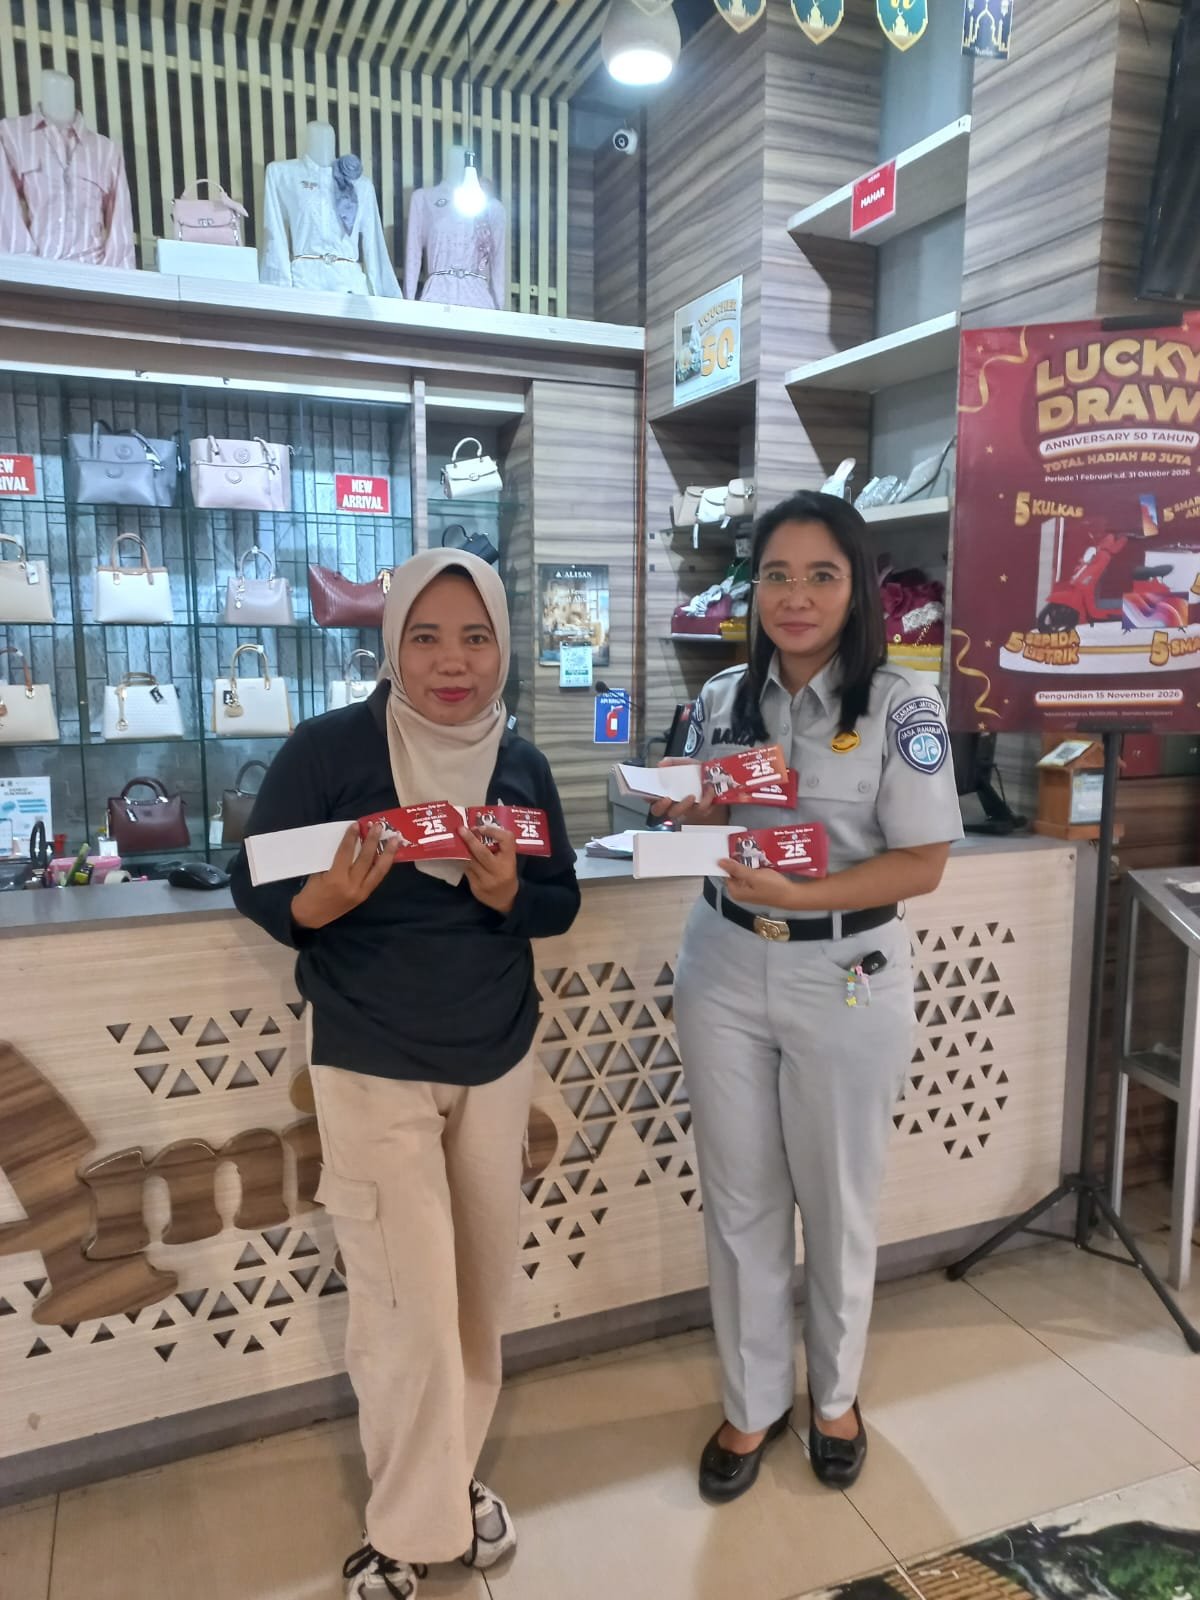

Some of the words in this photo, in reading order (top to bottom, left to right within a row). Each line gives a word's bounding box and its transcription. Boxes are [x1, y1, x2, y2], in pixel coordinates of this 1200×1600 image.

[861, 186, 885, 208] MAHAR
[701, 326, 734, 377] 50
[1036, 338, 1200, 396] LUCKY
[1038, 383, 1200, 432] DRAW
[1045, 431, 1130, 452] ANNIVERSARY
[1134, 431, 1148, 440] 50
[1152, 431, 1194, 444] TAHUN
[1043, 456, 1085, 473] TOTAL
[1087, 451, 1137, 465] HADIAH
[1158, 452, 1191, 466] JUTA
[351, 479, 373, 493] NEW
[1044, 474, 1074, 483] Periode
[1080, 473, 1112, 481] Februari
[1137, 470, 1169, 478] Oktober
[342, 494, 384, 510] ARRIVAL
[1014, 491, 1030, 526] 5
[1032, 499, 1084, 518] KULKAS
[1005, 631, 1024, 653] 5
[1025, 629, 1080, 647] SEPEDA
[1150, 630, 1169, 666] 5
[1038, 691, 1093, 701] Pengundian
[1107, 690, 1154, 700] November
[1157, 690, 1180, 698] 2026
[901, 728, 917, 740] JASA
[423, 819, 443, 835] 25
[521, 824, 537, 838] 25
[785, 843, 804, 858] 25
